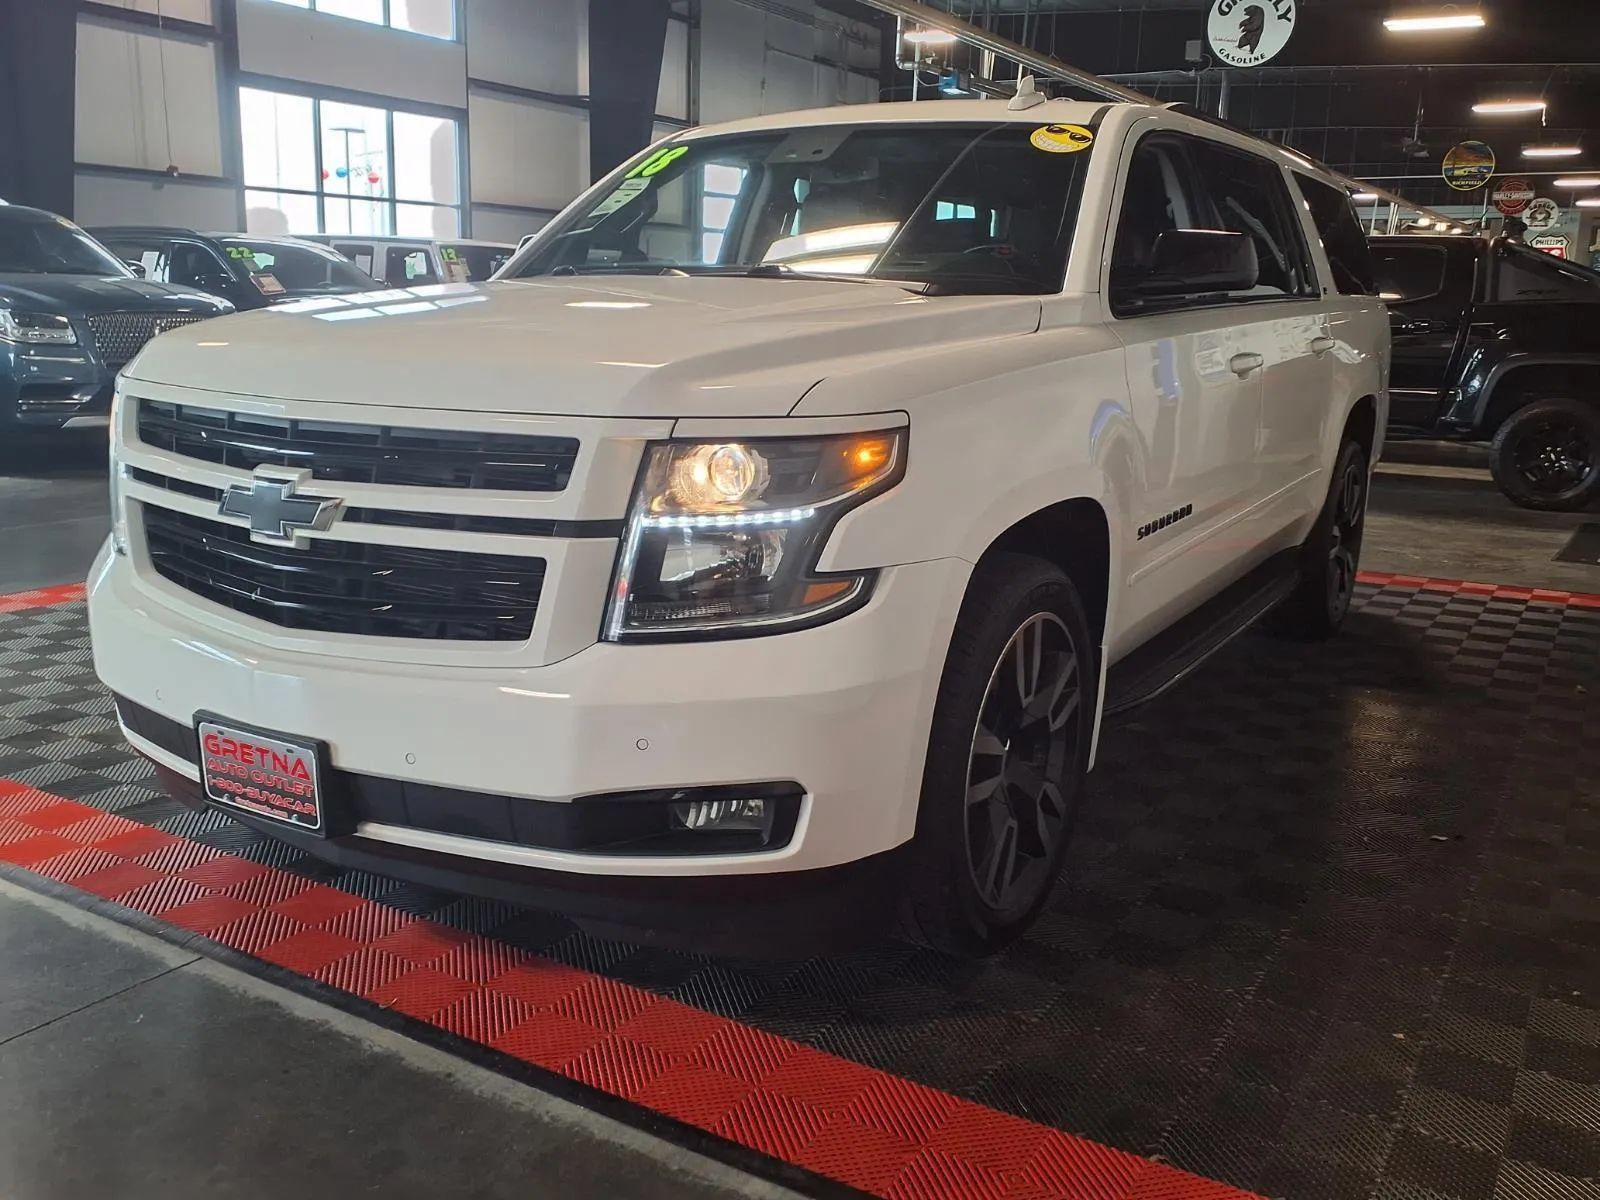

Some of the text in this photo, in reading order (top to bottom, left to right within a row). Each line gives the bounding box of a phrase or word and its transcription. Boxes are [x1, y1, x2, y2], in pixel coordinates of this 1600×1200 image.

[1219, 48, 1266, 64] GASOLINE
[625, 146, 689, 178] 18
[226, 247, 253, 258] 22
[1136, 503, 1193, 541] SUBURBAN
[204, 733, 311, 781] GRETNA
[207, 758, 314, 798] AUTO OUTLET
[208, 774, 317, 816] 1-800-BUYACAR
